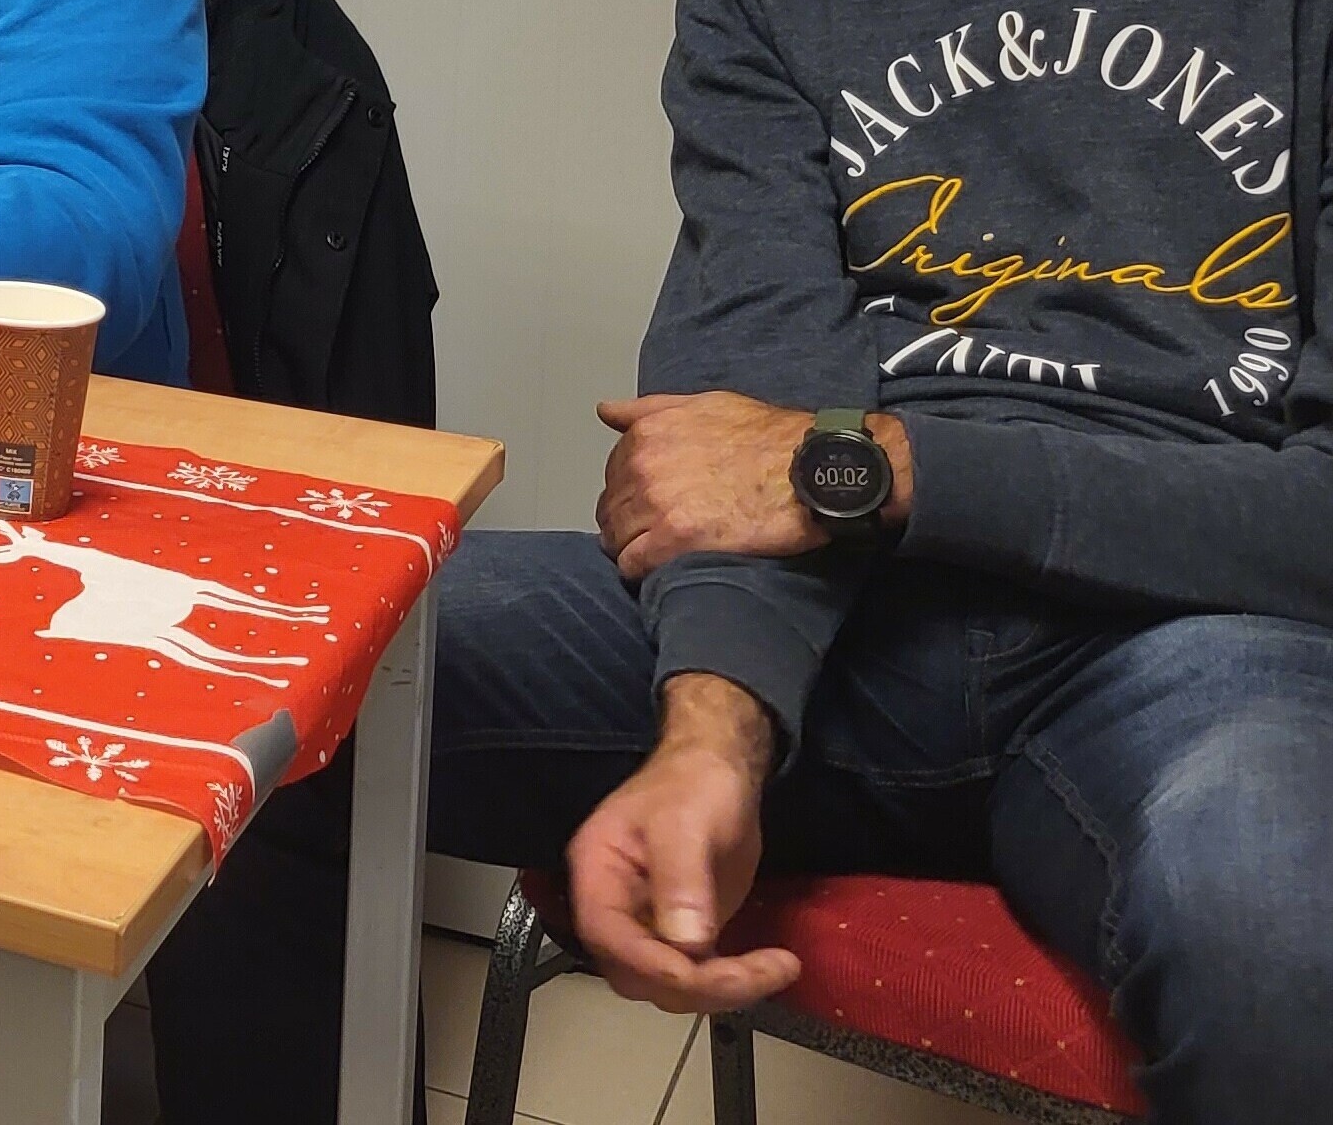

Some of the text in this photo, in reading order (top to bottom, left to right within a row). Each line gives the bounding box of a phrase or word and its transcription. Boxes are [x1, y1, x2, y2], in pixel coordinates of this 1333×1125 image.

[830, 7, 1292, 195] JACK&JONES
[841, 174, 1299, 325] Originals
[1202, 326, 1293, 418] 1990
[814, 466, 869, 487] 20:09
